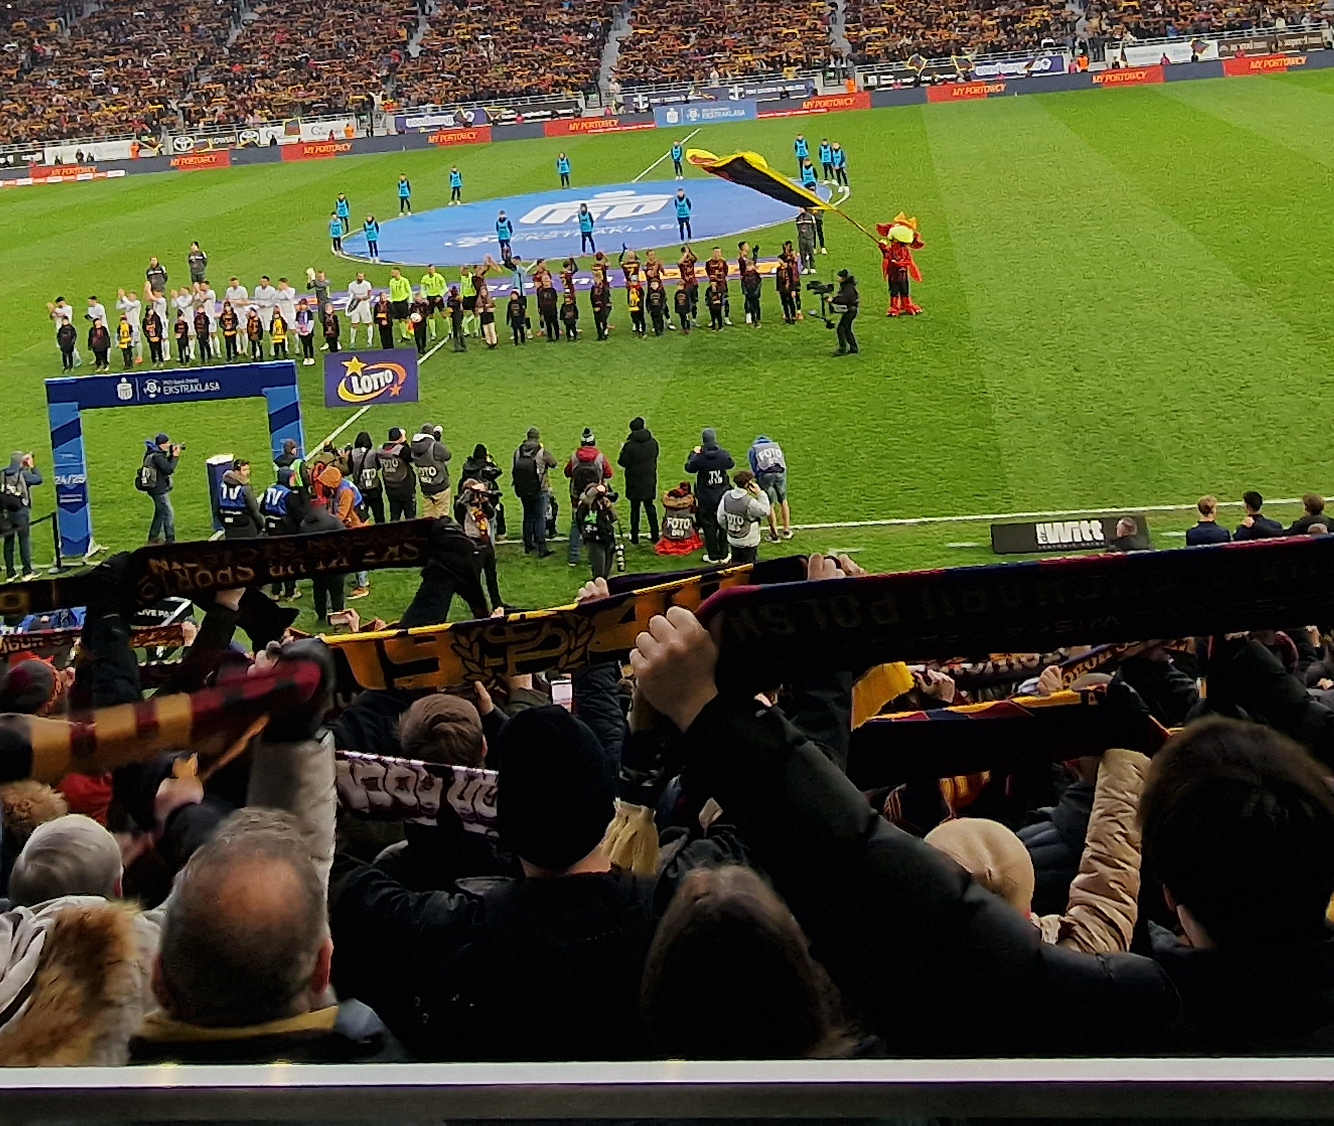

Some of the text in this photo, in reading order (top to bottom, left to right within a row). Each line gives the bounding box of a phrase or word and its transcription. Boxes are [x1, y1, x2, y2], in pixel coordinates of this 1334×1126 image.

[163, 381, 220, 394] EKSTRAKLASA
[351, 370, 394, 394] LOTTO
[757, 448, 782, 463] FOTO
[55, 474, 86, 485] 24/25
[221, 482, 241, 500] TV
[667, 517, 691, 530] FOTO
